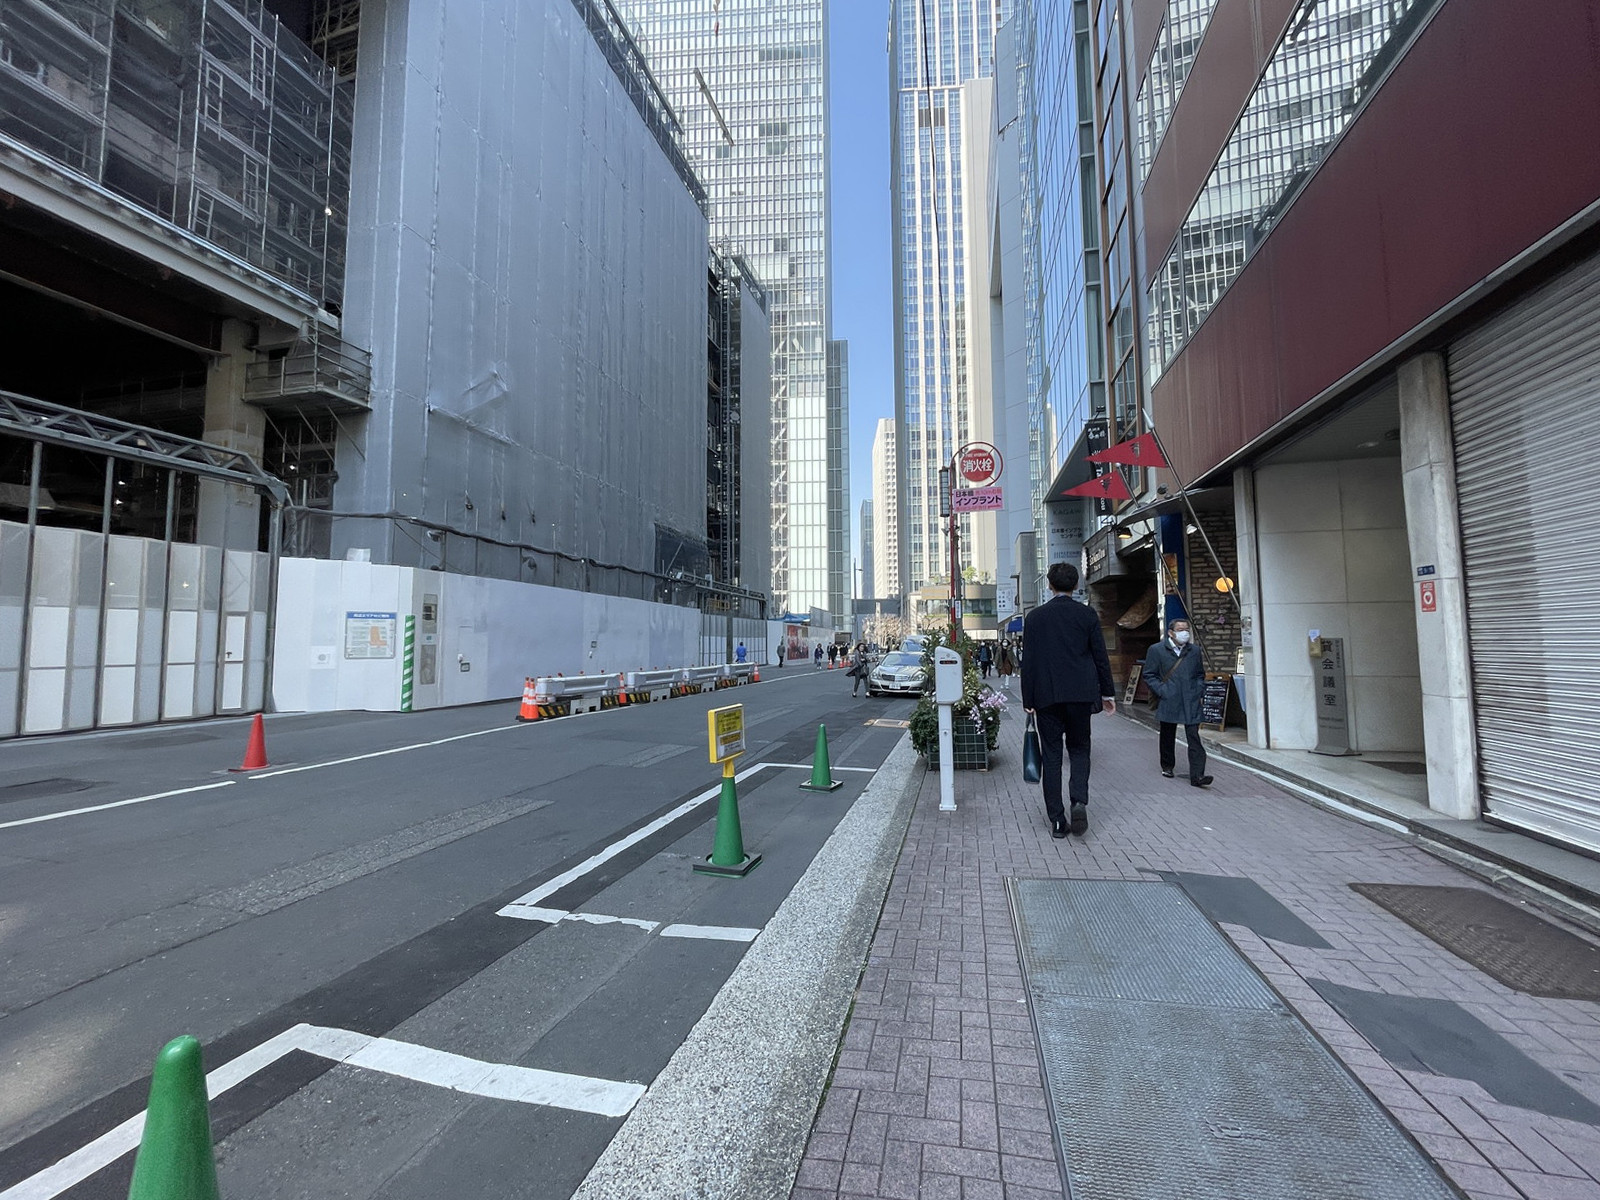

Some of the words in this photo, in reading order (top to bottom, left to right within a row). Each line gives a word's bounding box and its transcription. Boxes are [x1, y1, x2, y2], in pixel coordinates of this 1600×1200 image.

[963, 458, 993, 473] 消火栓
[955, 495, 1002, 506] インプラント
[1321, 639, 1337, 706] 貸会議室
